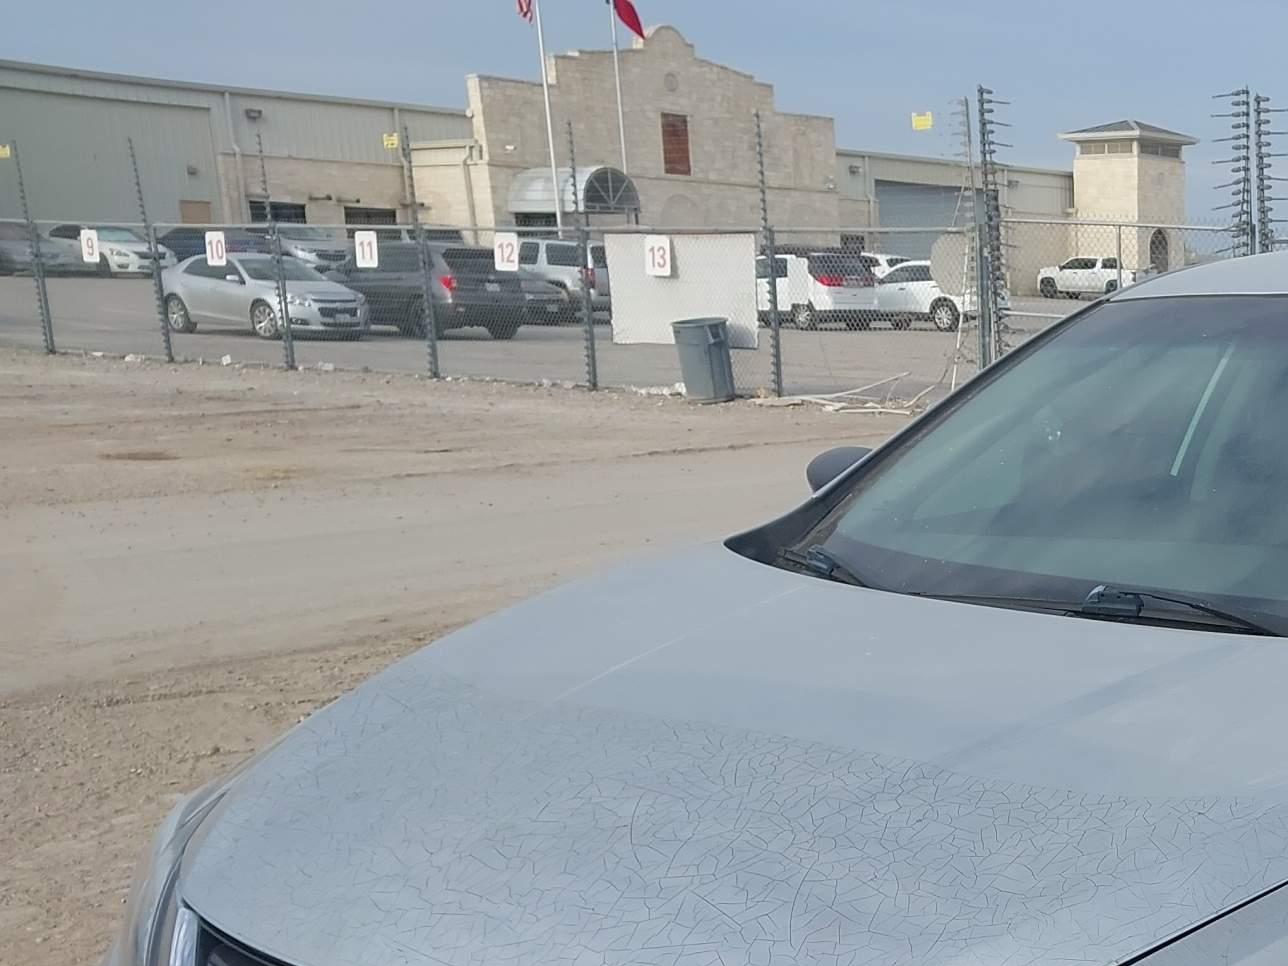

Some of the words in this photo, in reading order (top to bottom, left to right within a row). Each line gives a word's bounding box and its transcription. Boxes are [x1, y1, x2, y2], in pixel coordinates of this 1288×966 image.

[86, 238, 95, 257] 9
[207, 239, 226, 261] 10
[358, 240, 375, 263] 11
[497, 241, 515, 264] 12
[648, 246, 667, 269] 13
